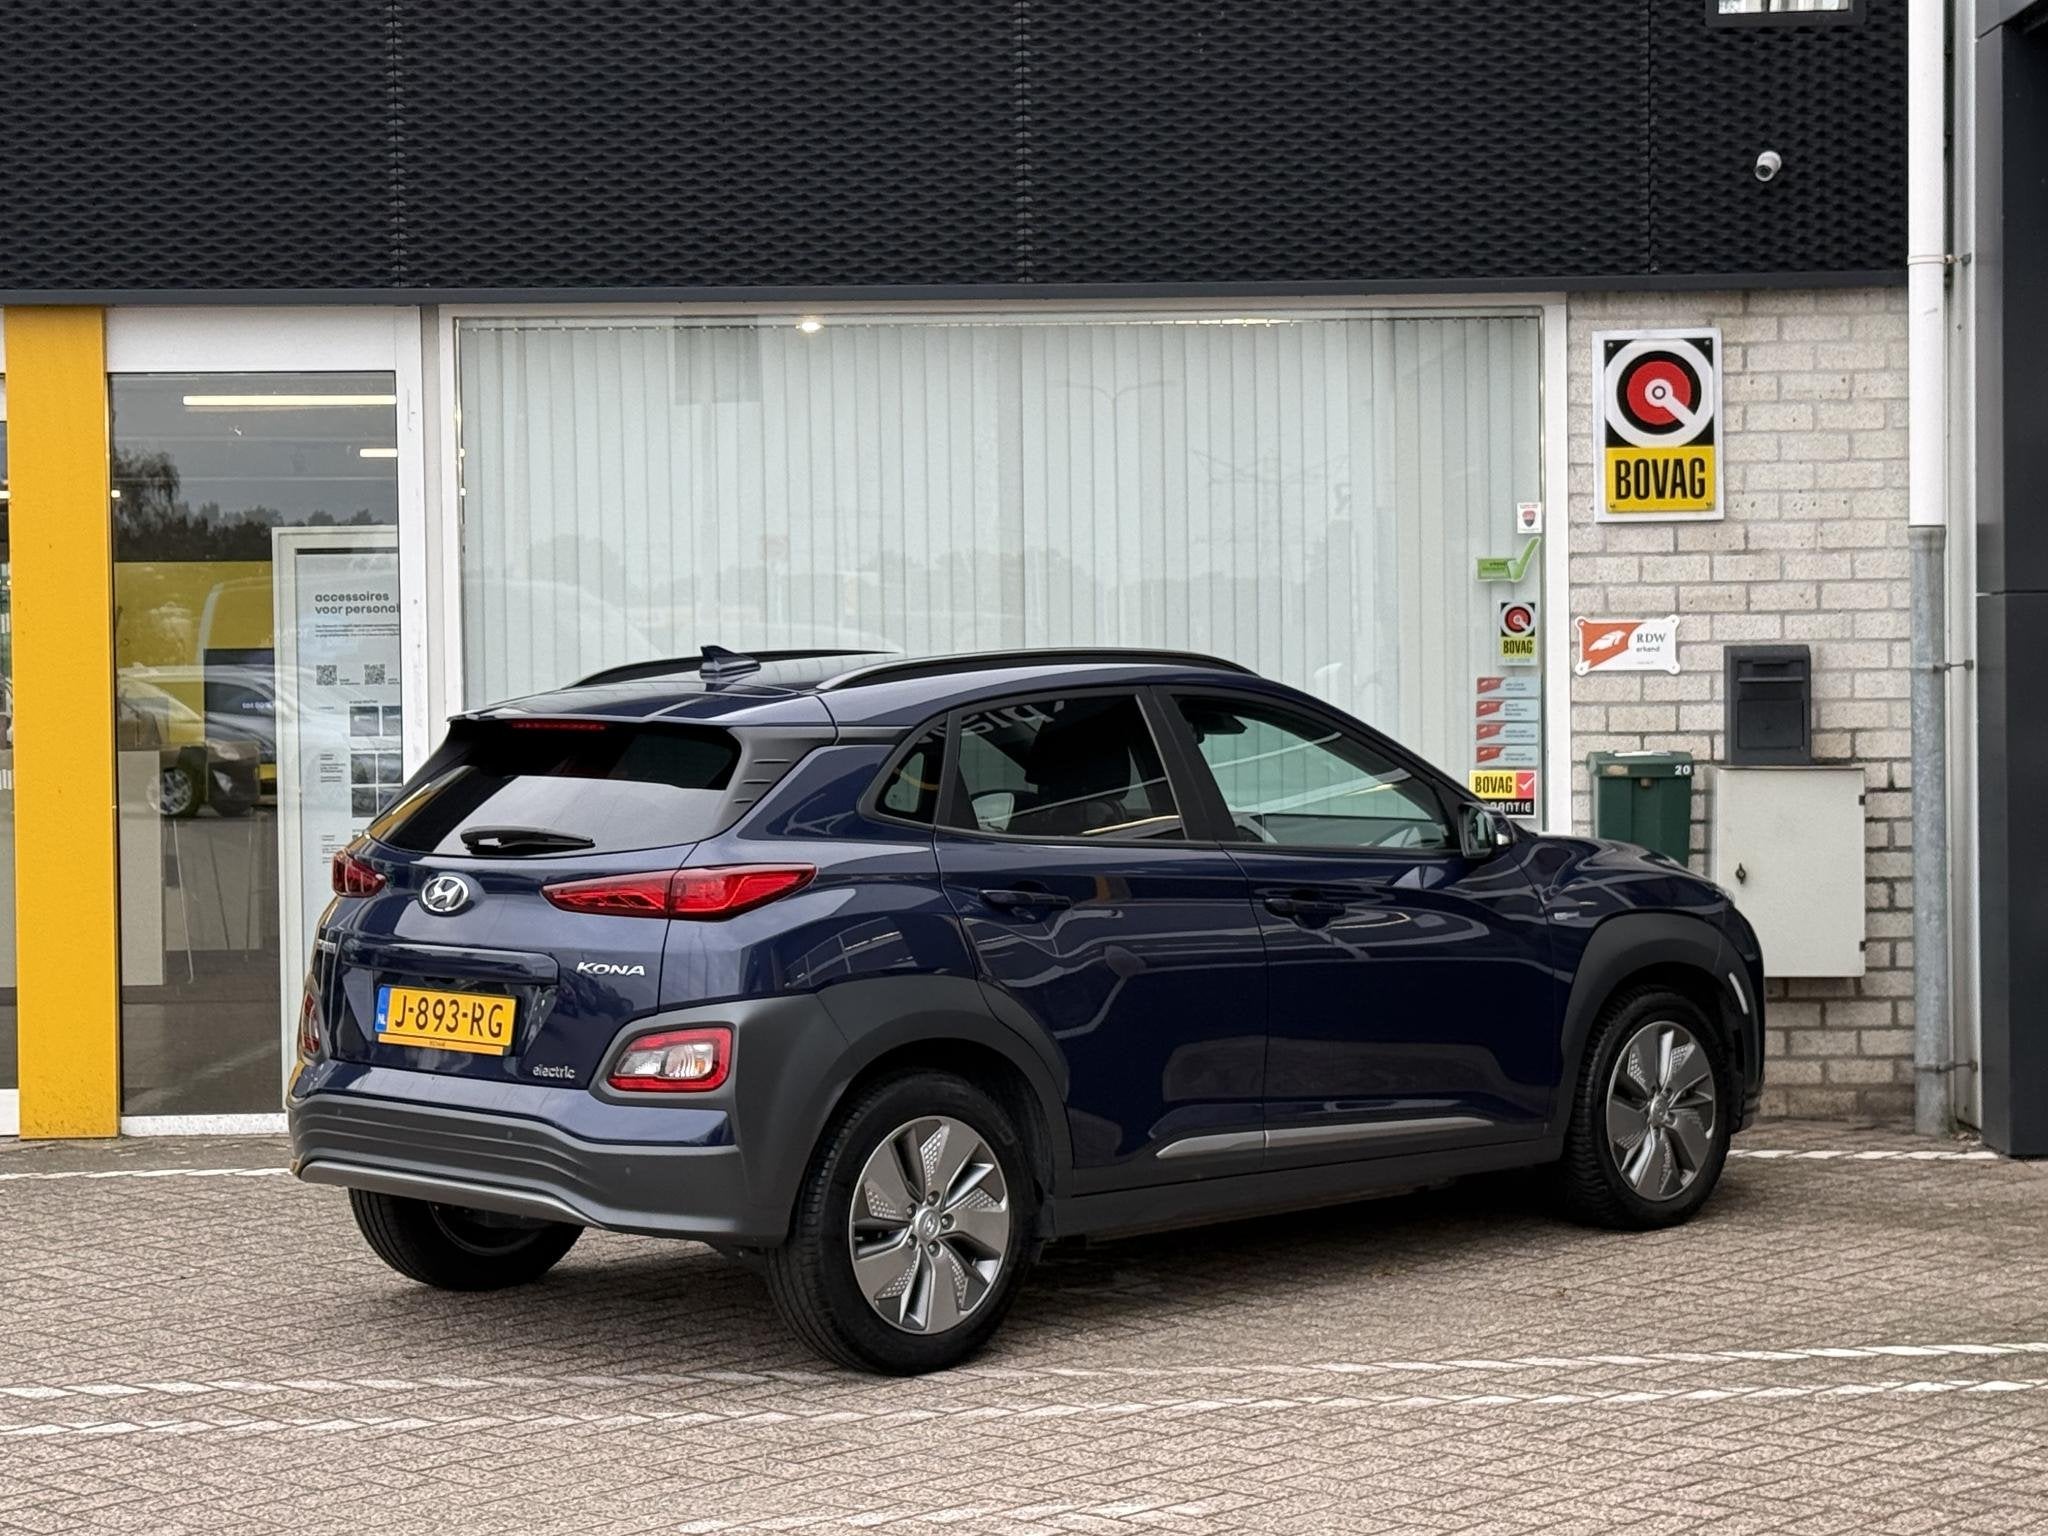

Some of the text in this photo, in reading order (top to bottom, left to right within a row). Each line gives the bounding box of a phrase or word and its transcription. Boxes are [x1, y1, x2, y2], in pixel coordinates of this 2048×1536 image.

[1615, 457, 1706, 500] BOVAG
[315, 591, 389, 602] accessoires
[315, 605, 342, 614] voor
[1636, 633, 1666, 643] RDW
[1503, 640, 1533, 655] BOVAG
[1674, 764, 1691, 776] 20
[1475, 776, 1513, 794] BOVAG
[576, 962, 646, 976] KONA
[394, 994, 505, 1039] J-893-RG
[532, 1063, 576, 1079] electric
